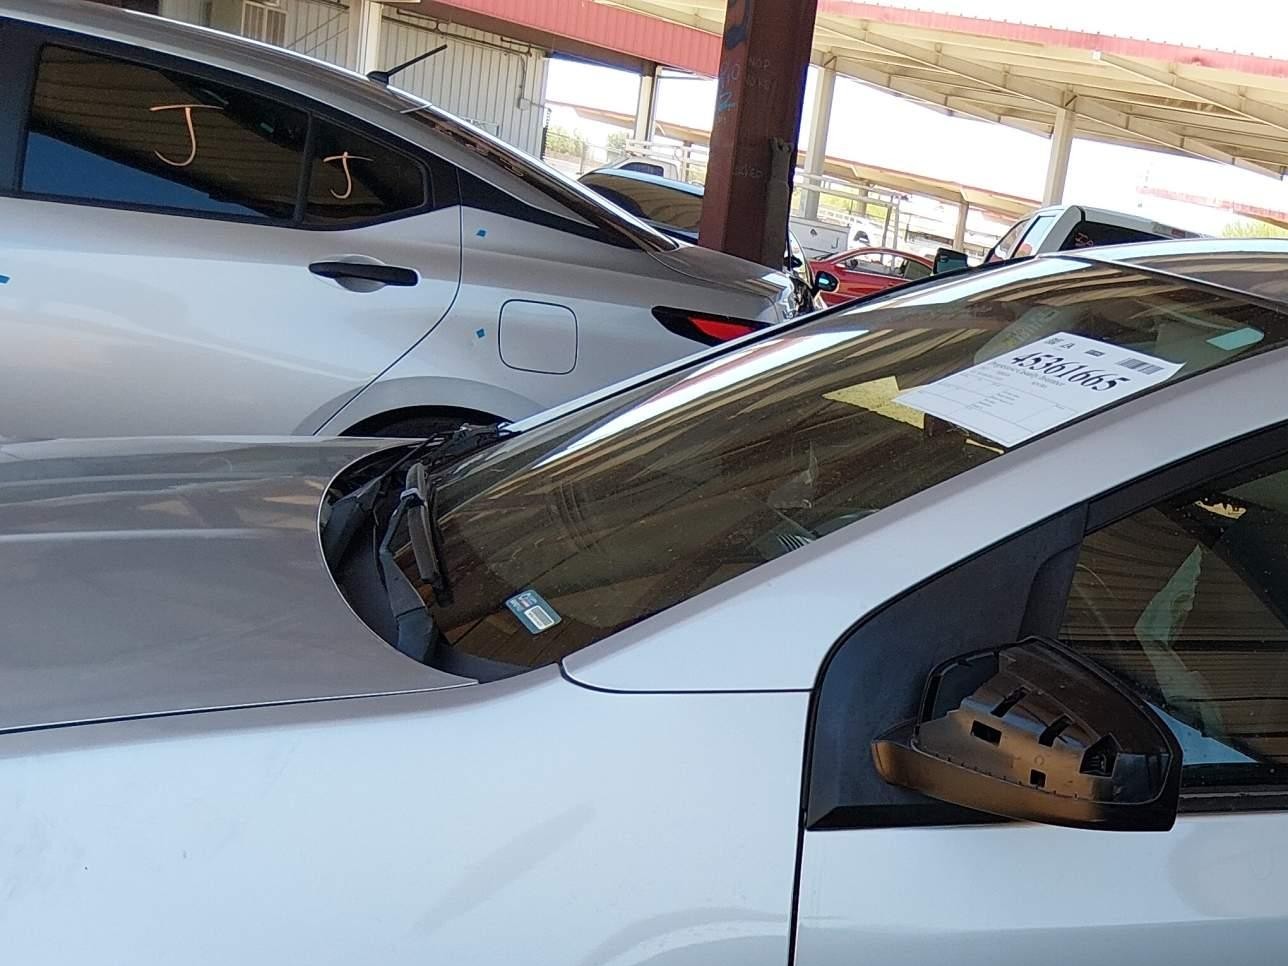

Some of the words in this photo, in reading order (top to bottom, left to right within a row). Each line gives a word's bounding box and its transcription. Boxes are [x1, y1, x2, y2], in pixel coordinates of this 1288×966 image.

[149, 104, 224, 166] J
[323, 151, 374, 200] J
[1010, 352, 1131, 392] 45361665
